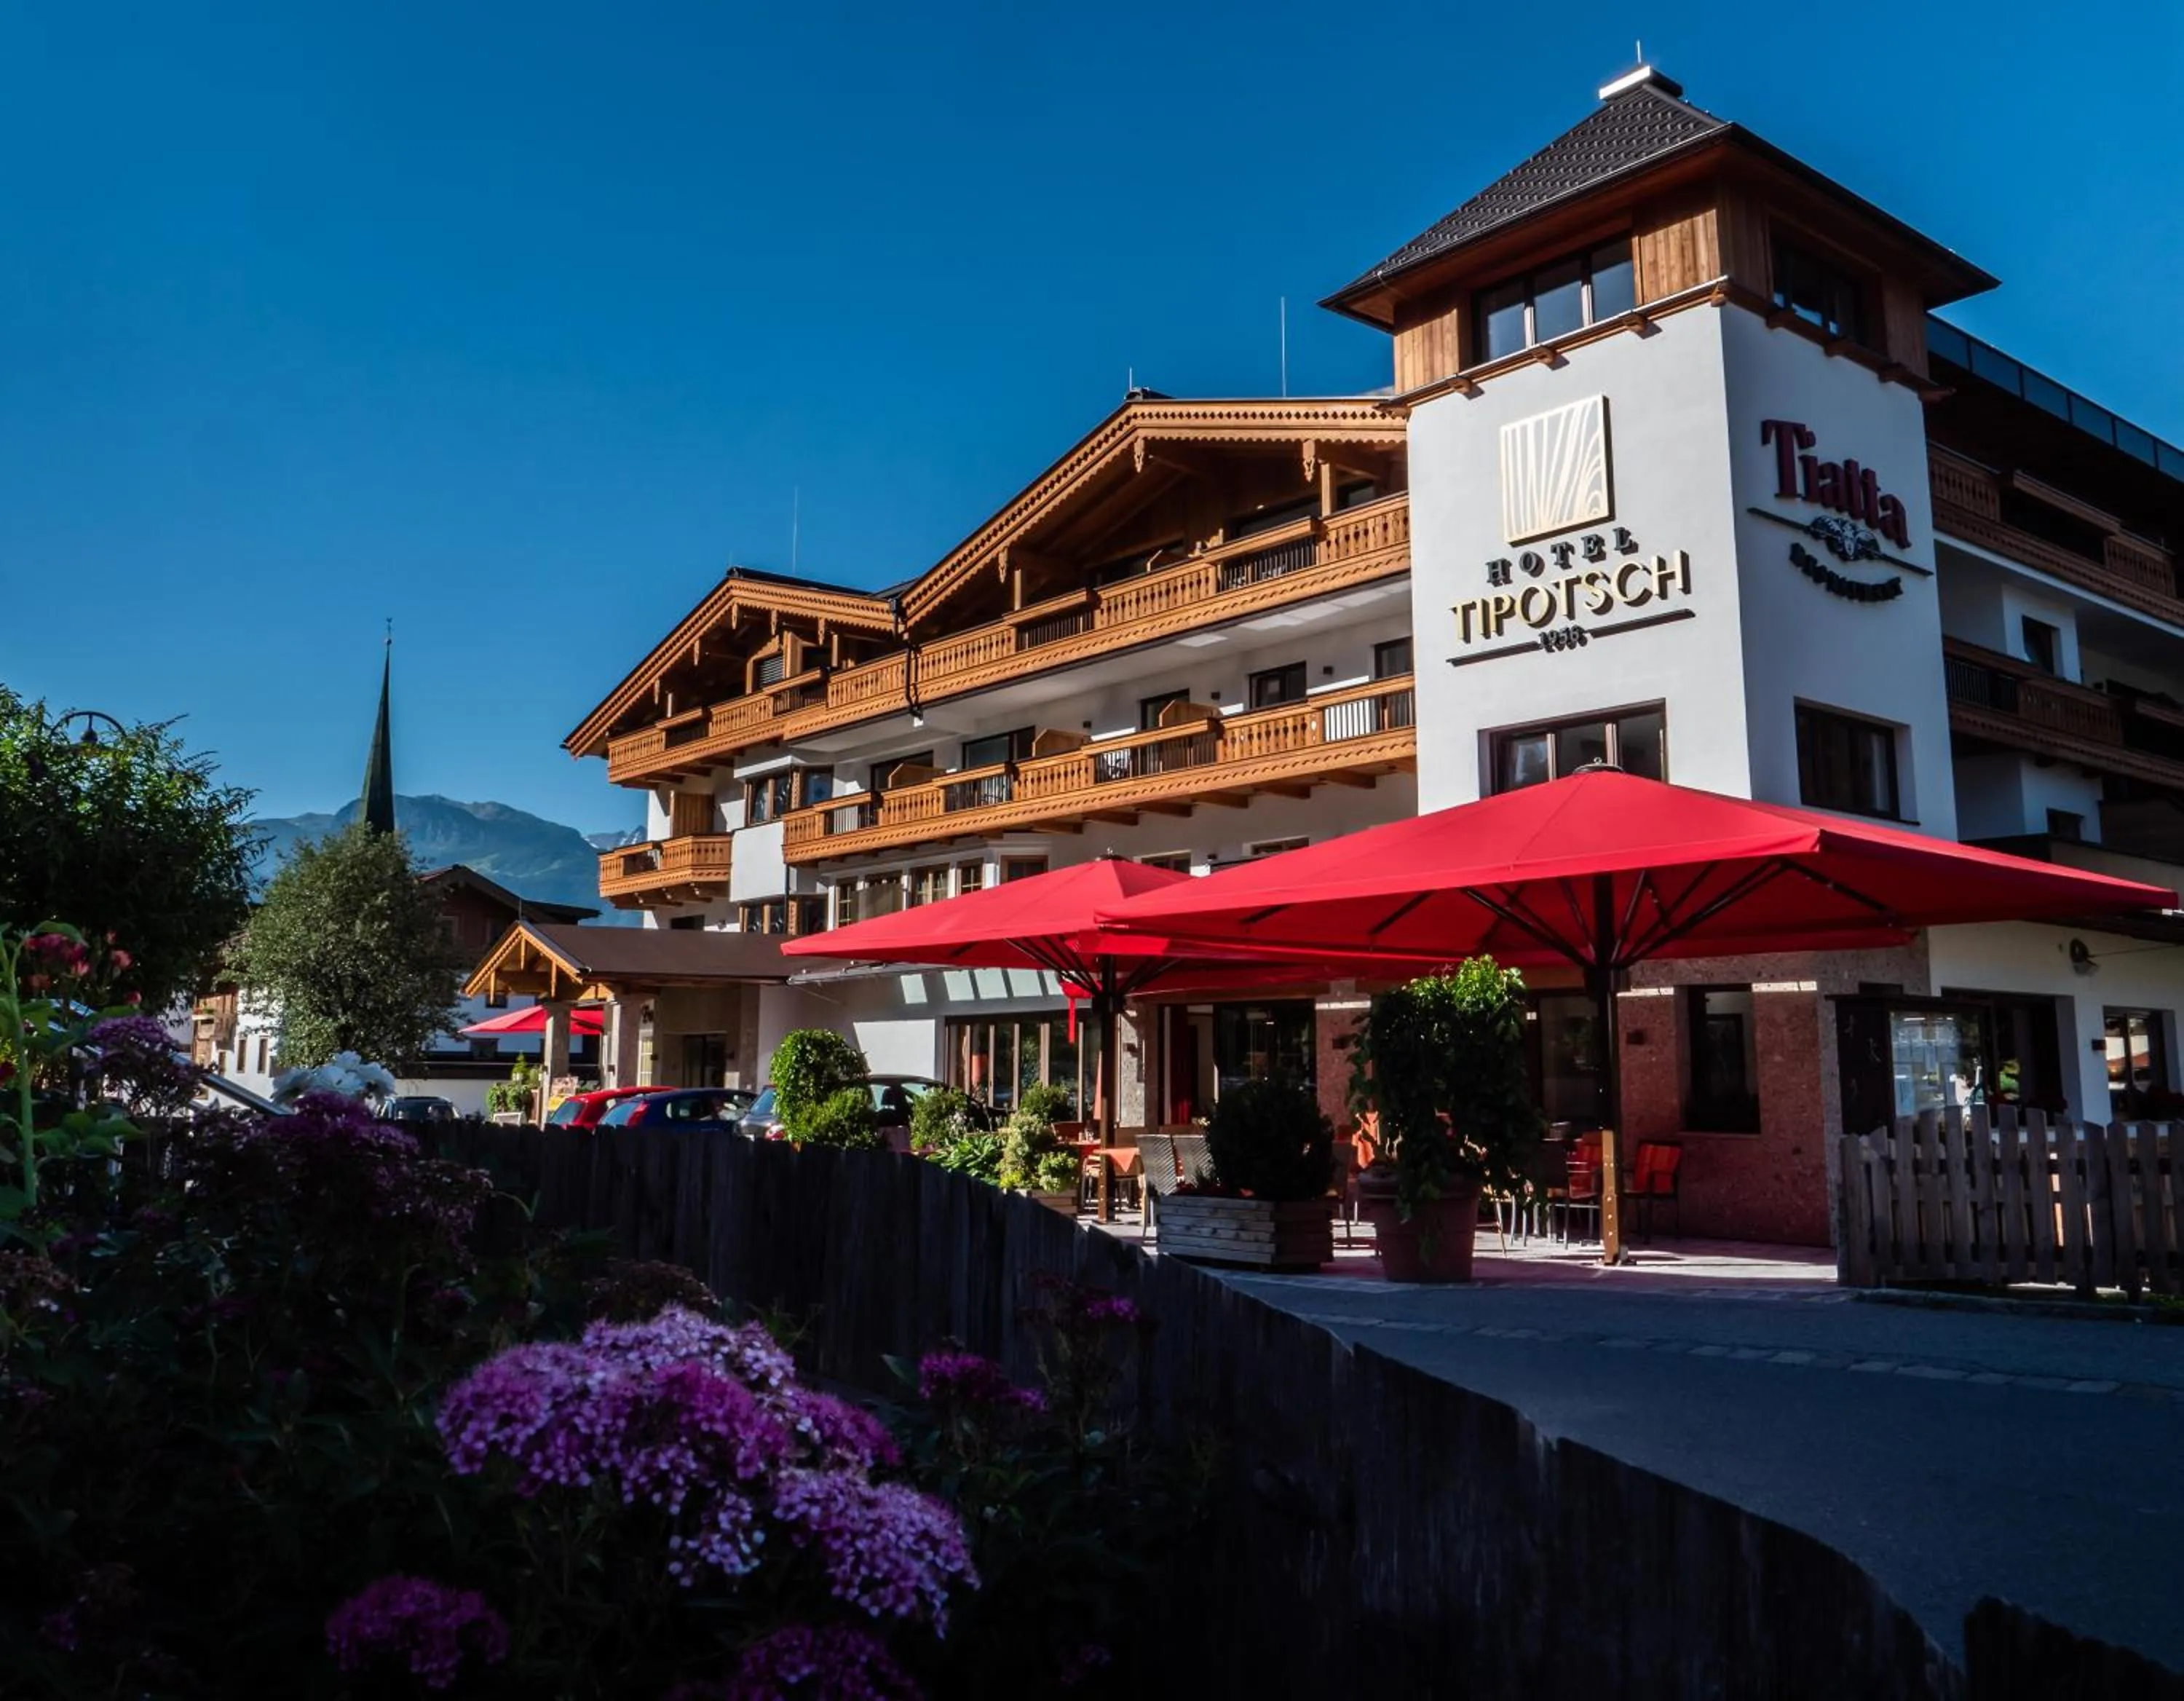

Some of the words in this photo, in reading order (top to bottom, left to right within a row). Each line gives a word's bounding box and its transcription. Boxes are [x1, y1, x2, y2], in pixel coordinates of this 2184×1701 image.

[1485, 526, 1637, 585] HOTEL
[1451, 550, 1690, 643] TIPOTSCH
[1538, 624, 1585, 651] 1956
